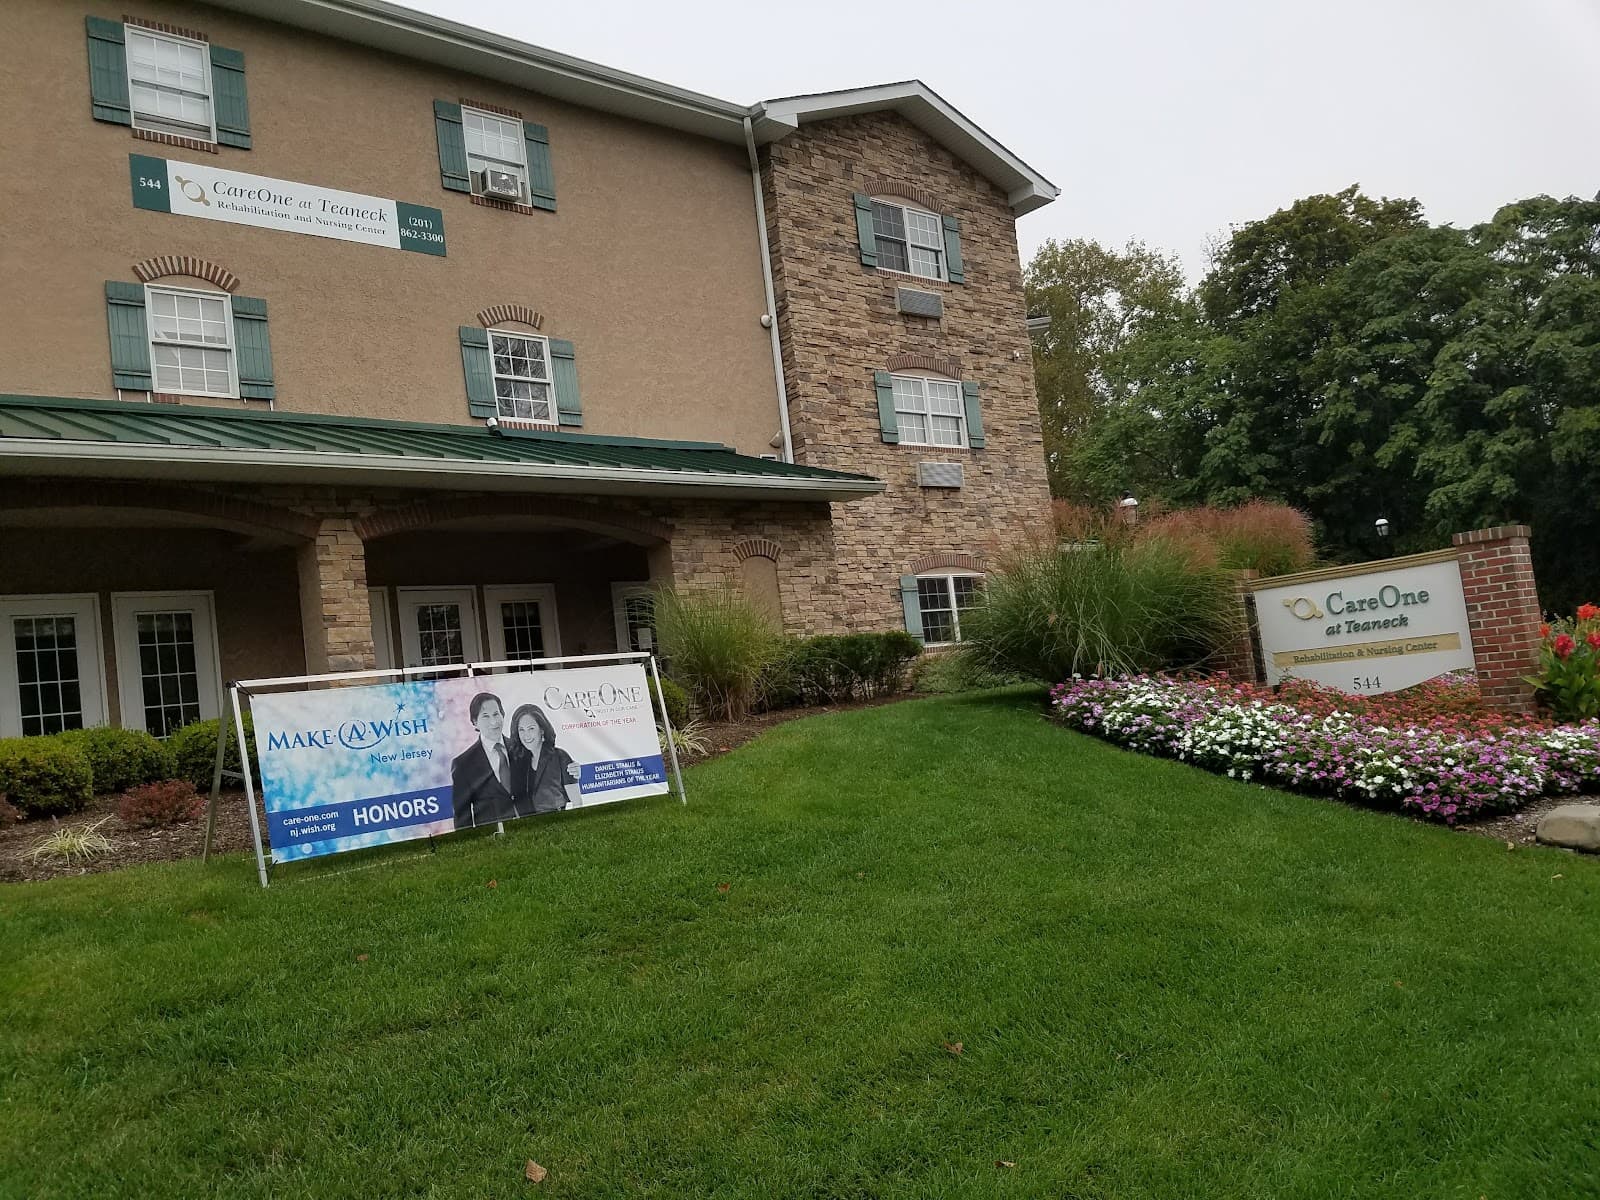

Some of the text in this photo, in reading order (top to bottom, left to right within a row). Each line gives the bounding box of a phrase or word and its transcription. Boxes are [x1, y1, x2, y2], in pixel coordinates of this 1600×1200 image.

[139, 177, 161, 190] 544
[213, 181, 388, 223] CareOne at Teaneck
[217, 200, 386, 235] Rehabilitation and Nursing Center
[408, 217, 433, 230] (201)
[400, 228, 444, 243] 862-3300
[1326, 585, 1430, 615] CareOne
[1325, 614, 1409, 636] at Teaneck
[1293, 641, 1438, 664] Rehabilitation & Nursing Center
[1353, 676, 1382, 691] 544
[561, 720, 601, 730] CORPORATION
[609, 718, 622, 726] THE
[622, 717, 637, 725] YEAR
[370, 748, 433, 764] New Jersey
[594, 771, 624, 780] ELIZABETH
[581, 780, 626, 790] HUMANITARIANS
[283, 810, 339, 826] care-one.com
[352, 796, 440, 827] HONORS
[290, 822, 336, 838] nj.wish.org
